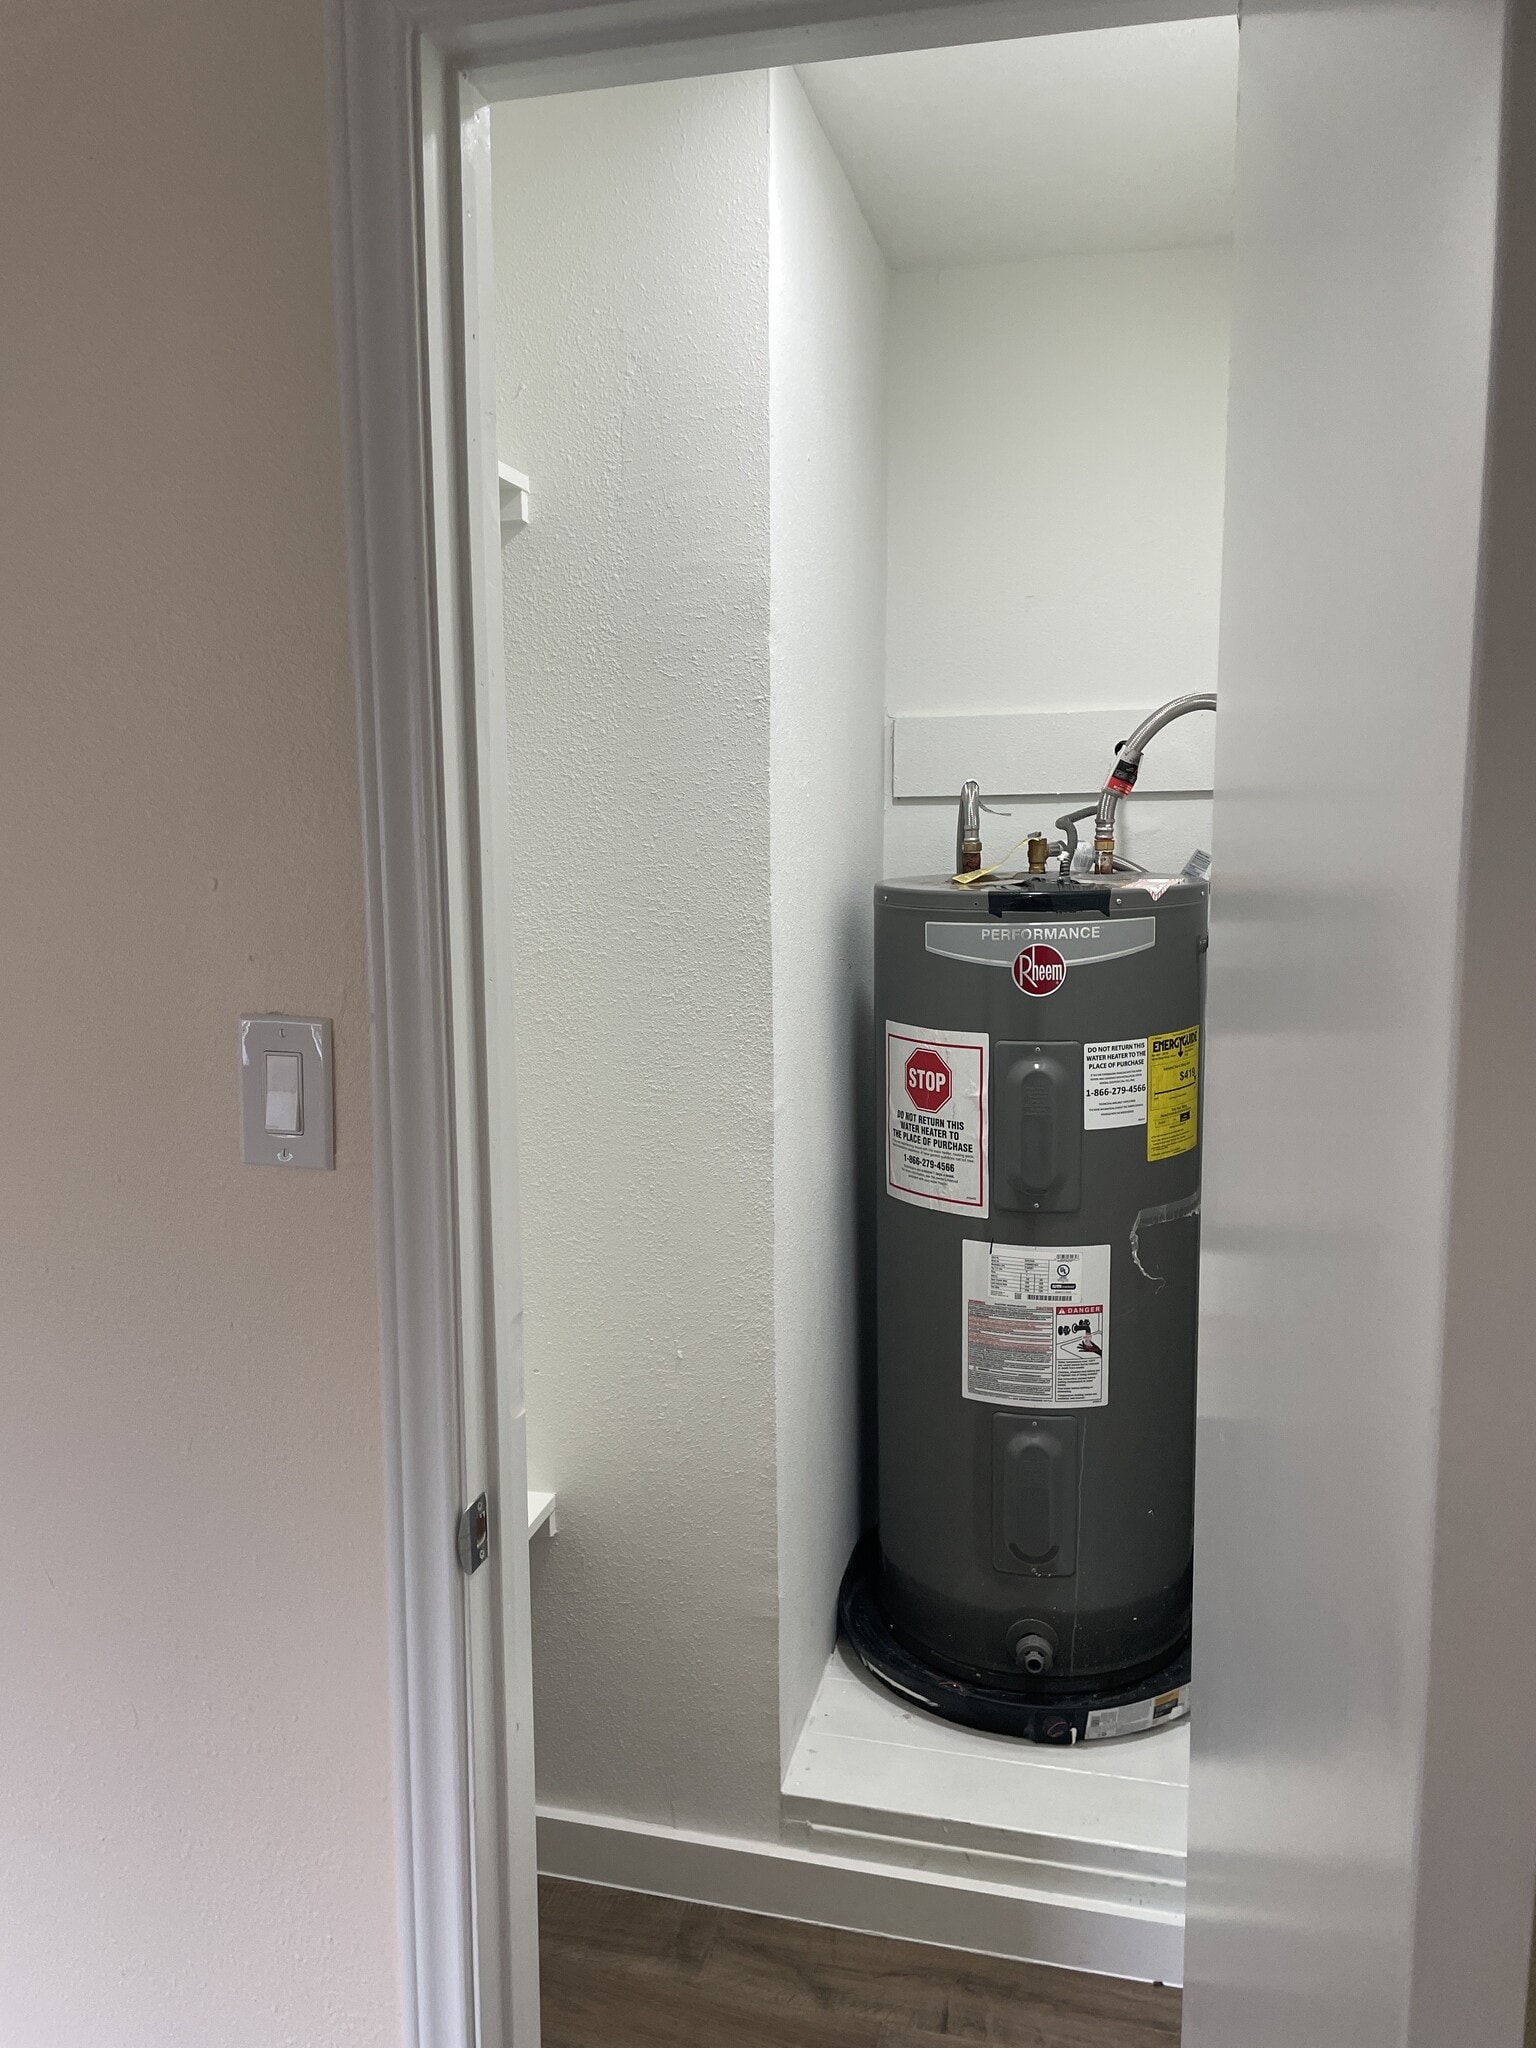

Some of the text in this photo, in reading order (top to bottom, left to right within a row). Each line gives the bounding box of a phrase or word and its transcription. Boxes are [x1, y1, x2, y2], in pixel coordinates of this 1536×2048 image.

[981, 926, 1100, 941] PERFORMANCE
[1019, 945, 1062, 988] Rheem
[1107, 1052, 1128, 1060] HEATER
[1116, 1059, 1145, 1067] PURCHASE
[909, 1068, 945, 1092] STOP
[1086, 1083, 1146, 1097] 1-866-279-4566
[897, 1109, 965, 1131] DO NOT RETURN THIS
[900, 1121, 959, 1140] WATER HEATER TO
[893, 1128, 902, 1139] THE
[902, 1131, 921, 1145] PLACE
[922, 1137, 932, 1147] OF
[933, 1139, 973, 1153] PURCHASE
[903, 1153, 955, 1173] 1-866-279-4566
[1067, 1306, 1100, 1314] DANGER
